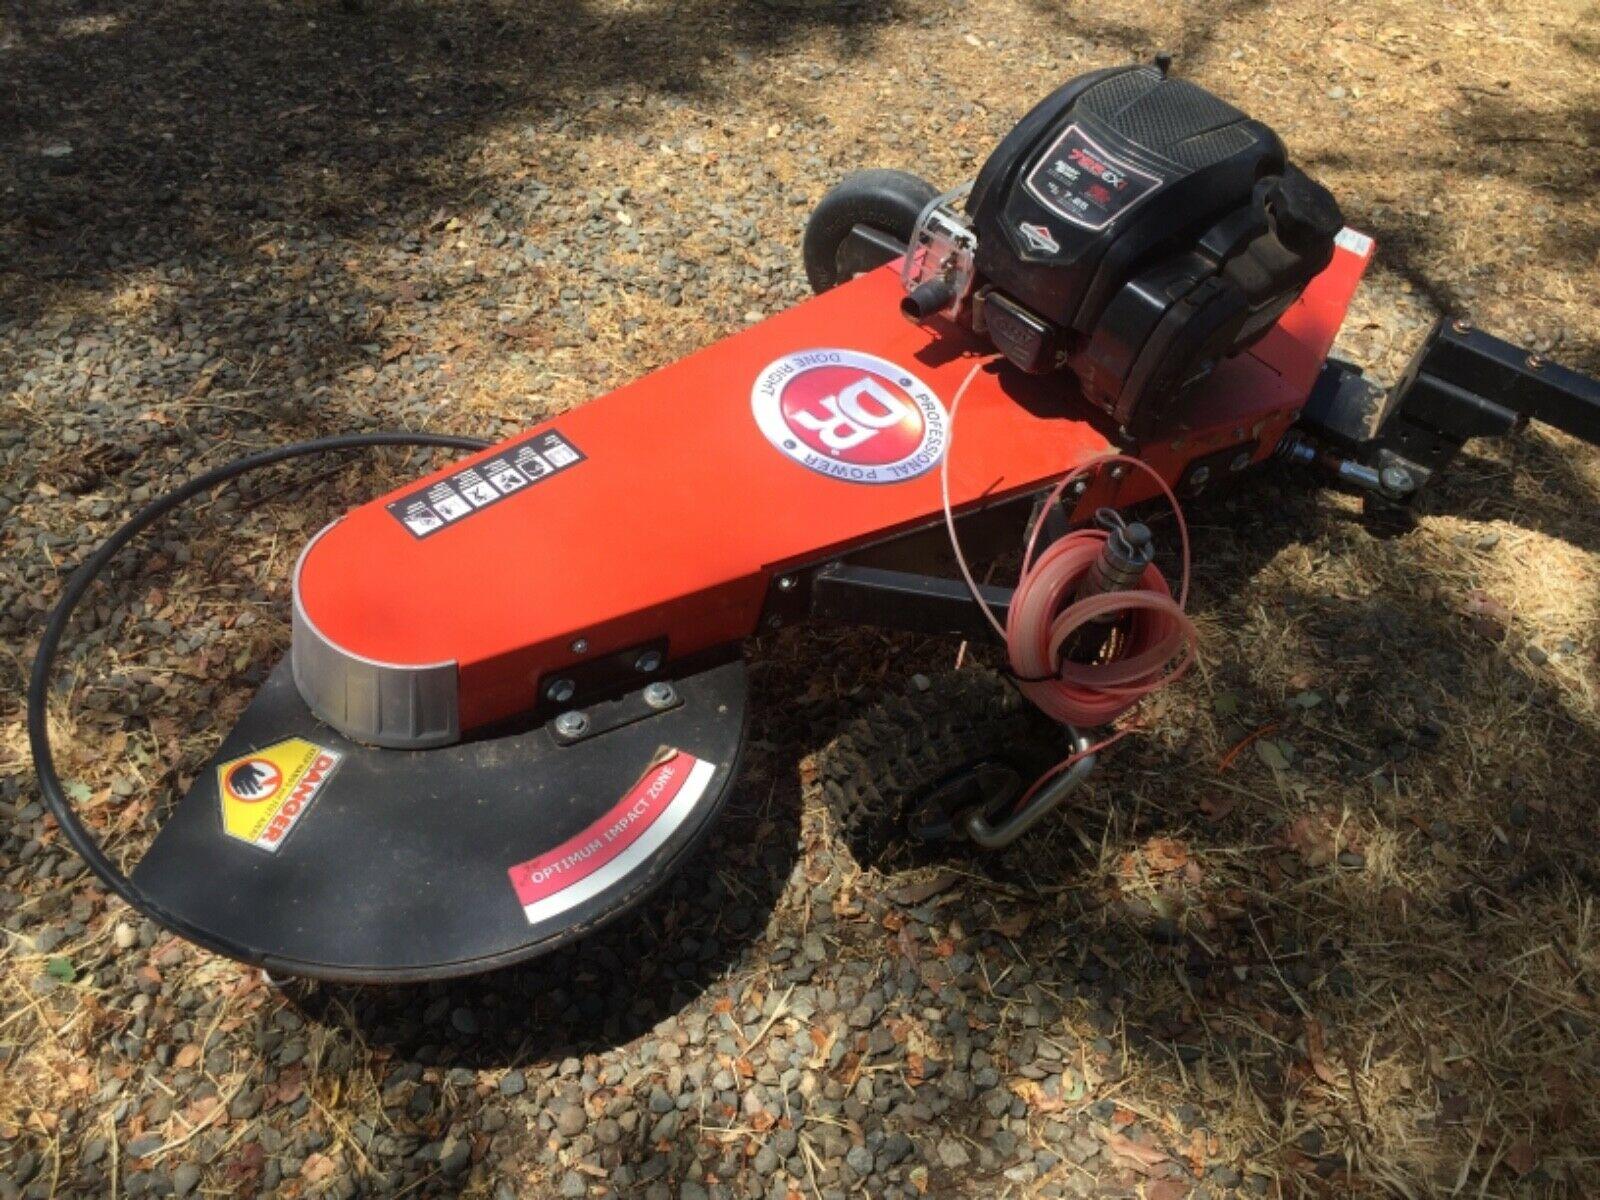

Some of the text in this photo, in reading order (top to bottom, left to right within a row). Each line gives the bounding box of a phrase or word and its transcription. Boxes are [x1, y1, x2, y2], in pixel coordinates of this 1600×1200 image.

[761, 352, 841, 397] DONE RIGHT
[789, 376, 910, 450] DR
[804, 393, 942, 480] PROFESSIONAL POWER
[262, 754, 334, 842] DANGER
[531, 766, 676, 884] OPTIMUM IMPACT ZONE
